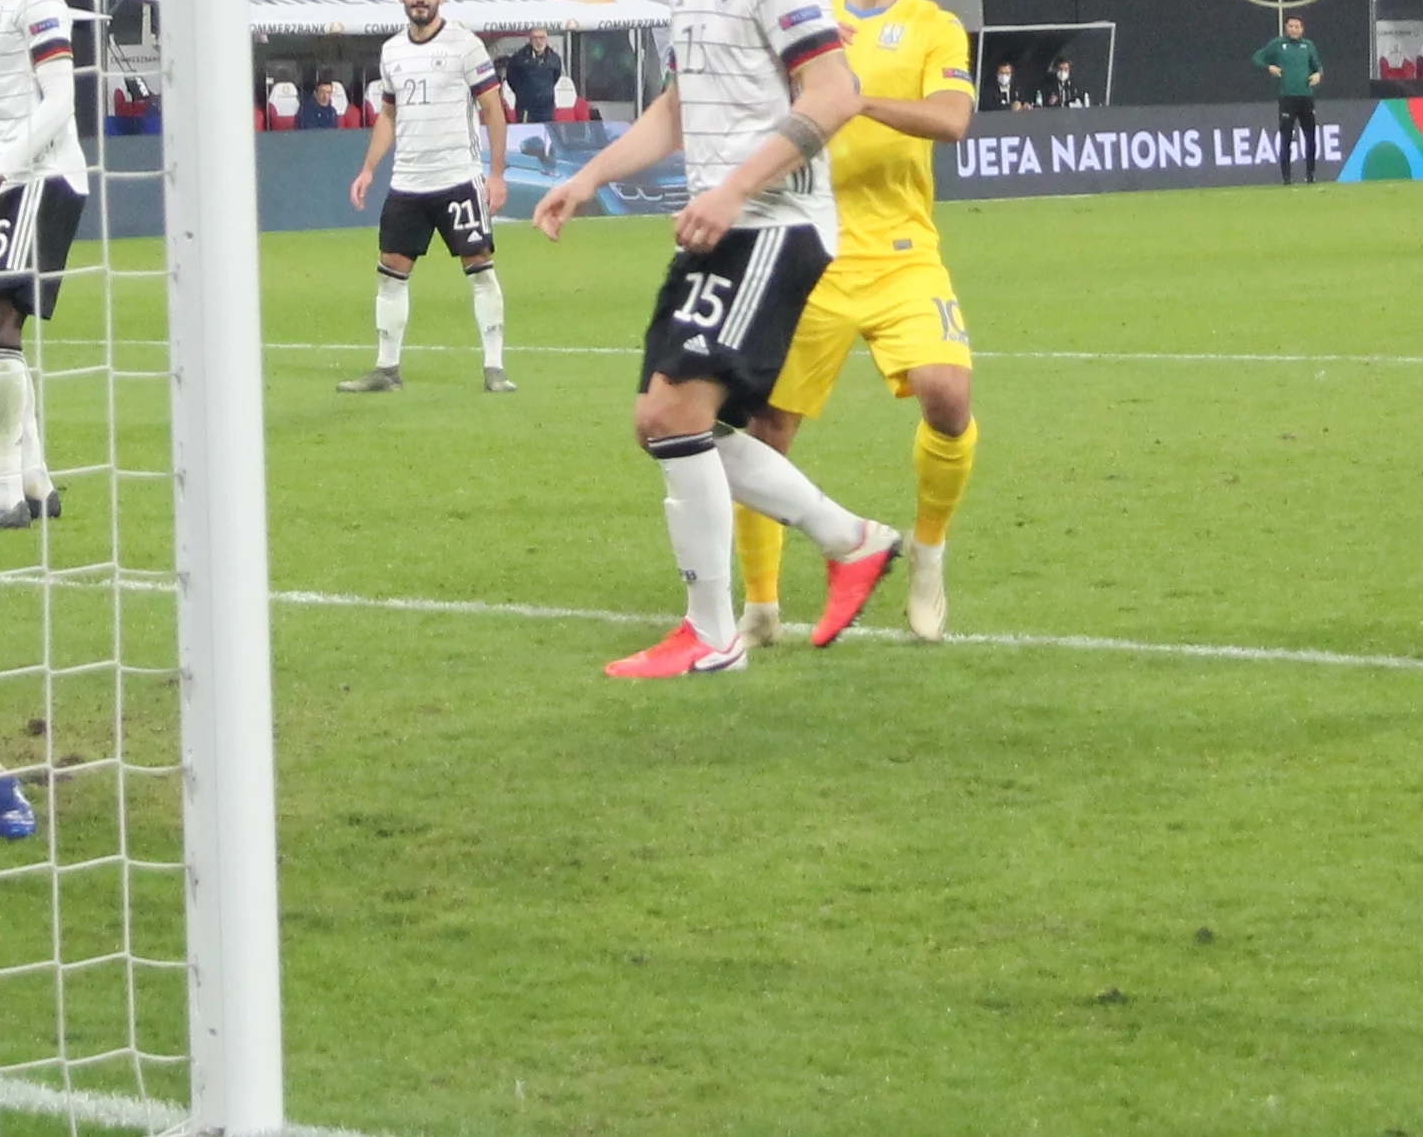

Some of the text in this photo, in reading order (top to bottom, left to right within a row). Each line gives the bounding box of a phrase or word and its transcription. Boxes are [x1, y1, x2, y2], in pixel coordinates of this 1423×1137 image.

[250, 23, 326, 34] OMMERZBANK
[404, 78, 431, 106] 21
[956, 135, 1042, 177] UEFA
[1051, 128, 1202, 173] NATIONS
[448, 198, 480, 230] 21
[673, 272, 732, 328] 15
